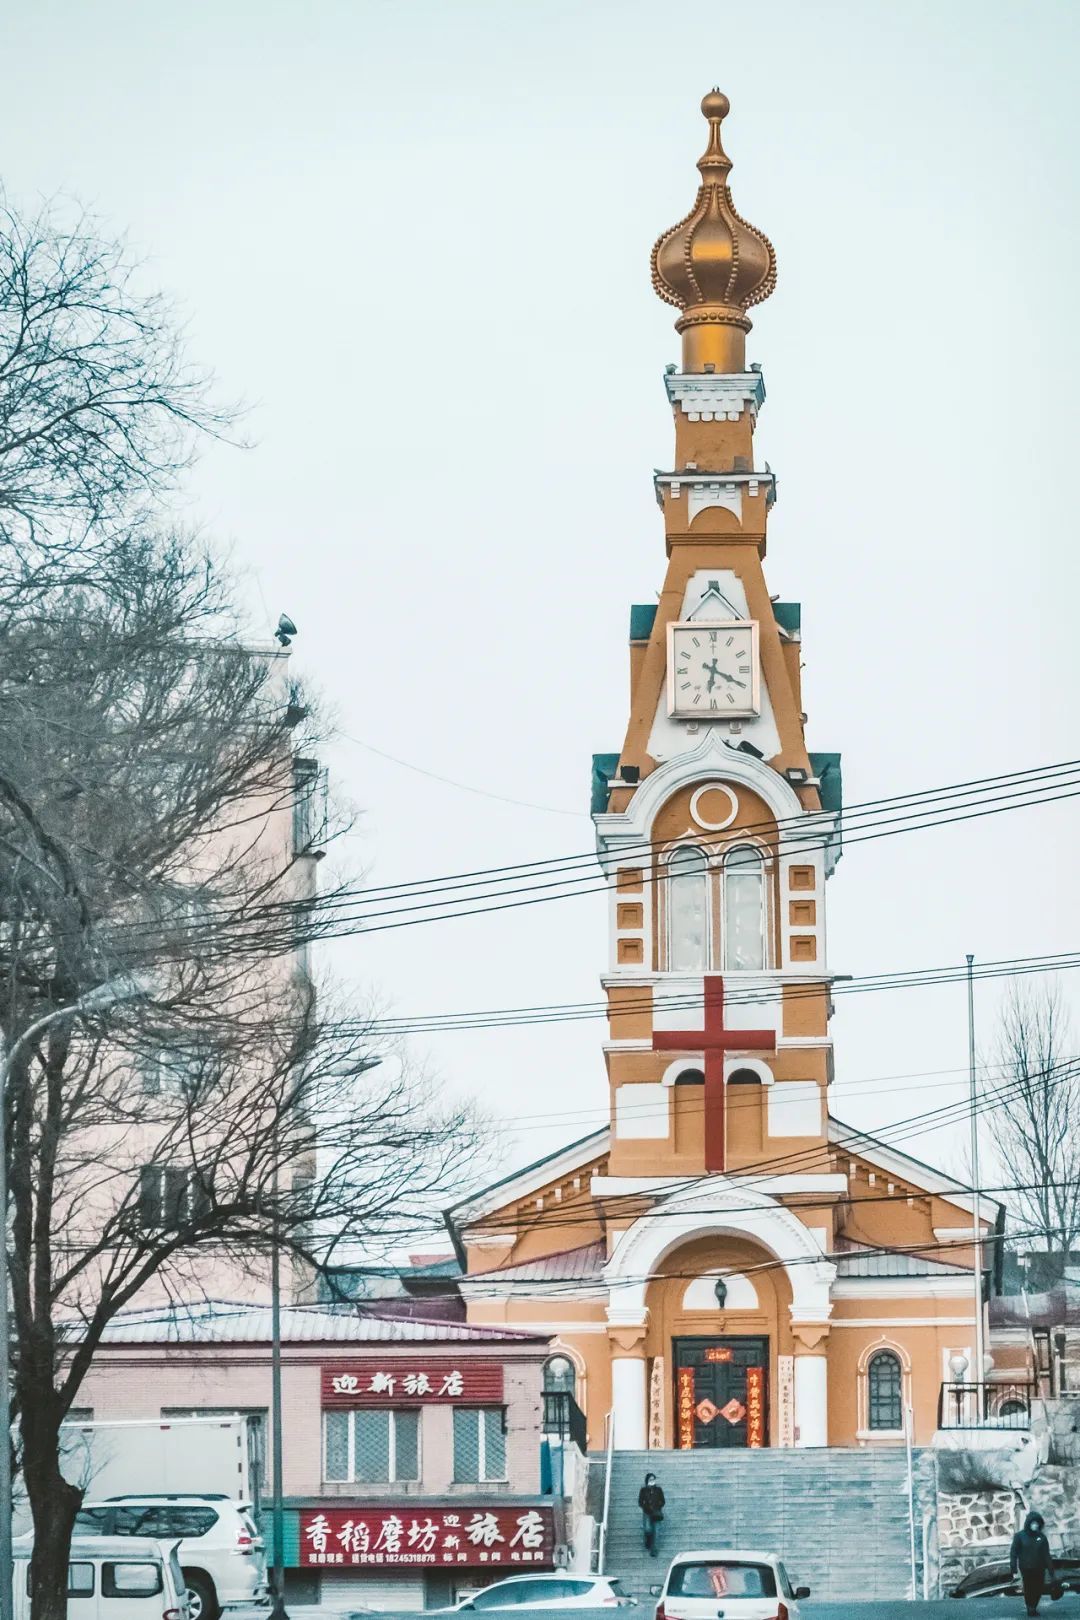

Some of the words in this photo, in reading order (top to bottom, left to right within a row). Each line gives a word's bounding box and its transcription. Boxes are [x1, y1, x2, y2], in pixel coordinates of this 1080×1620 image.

[332, 1371, 464, 1397] 迎新旅店
[306, 1514, 440, 1553] 香稻磨坊
[442, 1514, 462, 1550] 迎新
[464, 1511, 546, 1548] 旅店
